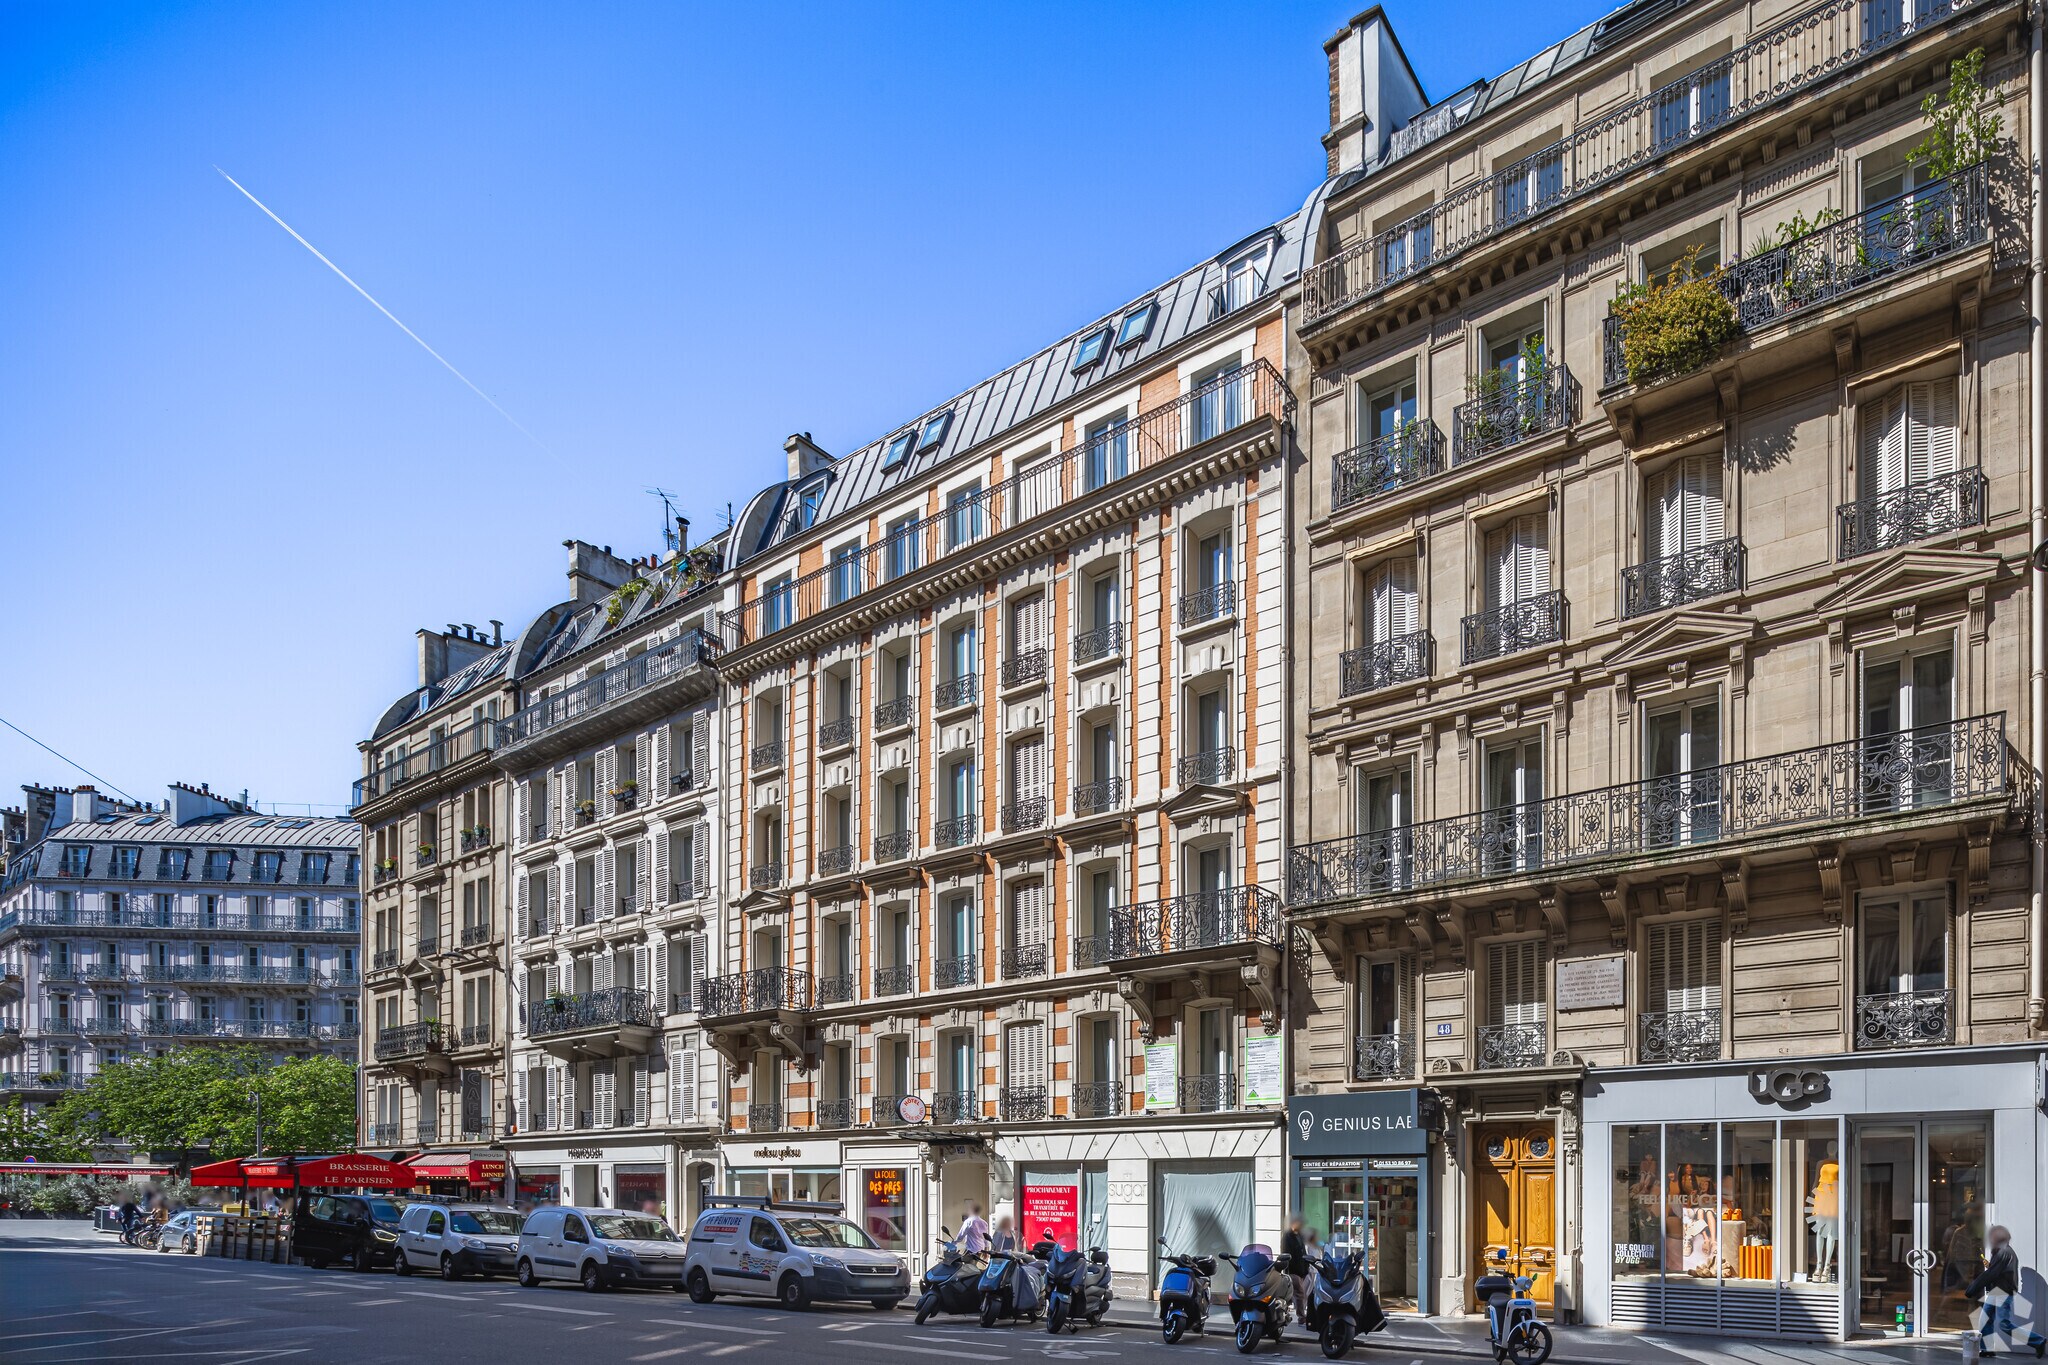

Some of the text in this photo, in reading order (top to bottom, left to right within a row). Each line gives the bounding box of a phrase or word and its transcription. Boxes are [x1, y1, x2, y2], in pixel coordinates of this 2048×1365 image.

[1438, 1024, 1450, 1034] 48
[1747, 1067, 1825, 1101] UGG
[467, 1072, 480, 1131] CAFE
[903, 1097, 920, 1106] HÔTEL
[1322, 1116, 1381, 1132] GENIUS
[329, 1162, 390, 1172] BRASSERIE
[324, 1176, 394, 1184] LE PARISIEN
[870, 1181, 882, 1195] DES
[1108, 1184, 1146, 1202] sugar
[1668, 1195, 1687, 1204] LIKE
[714, 1216, 742, 1226] PEINTURE
[1615, 1250, 1654, 1258] COLLECTION
